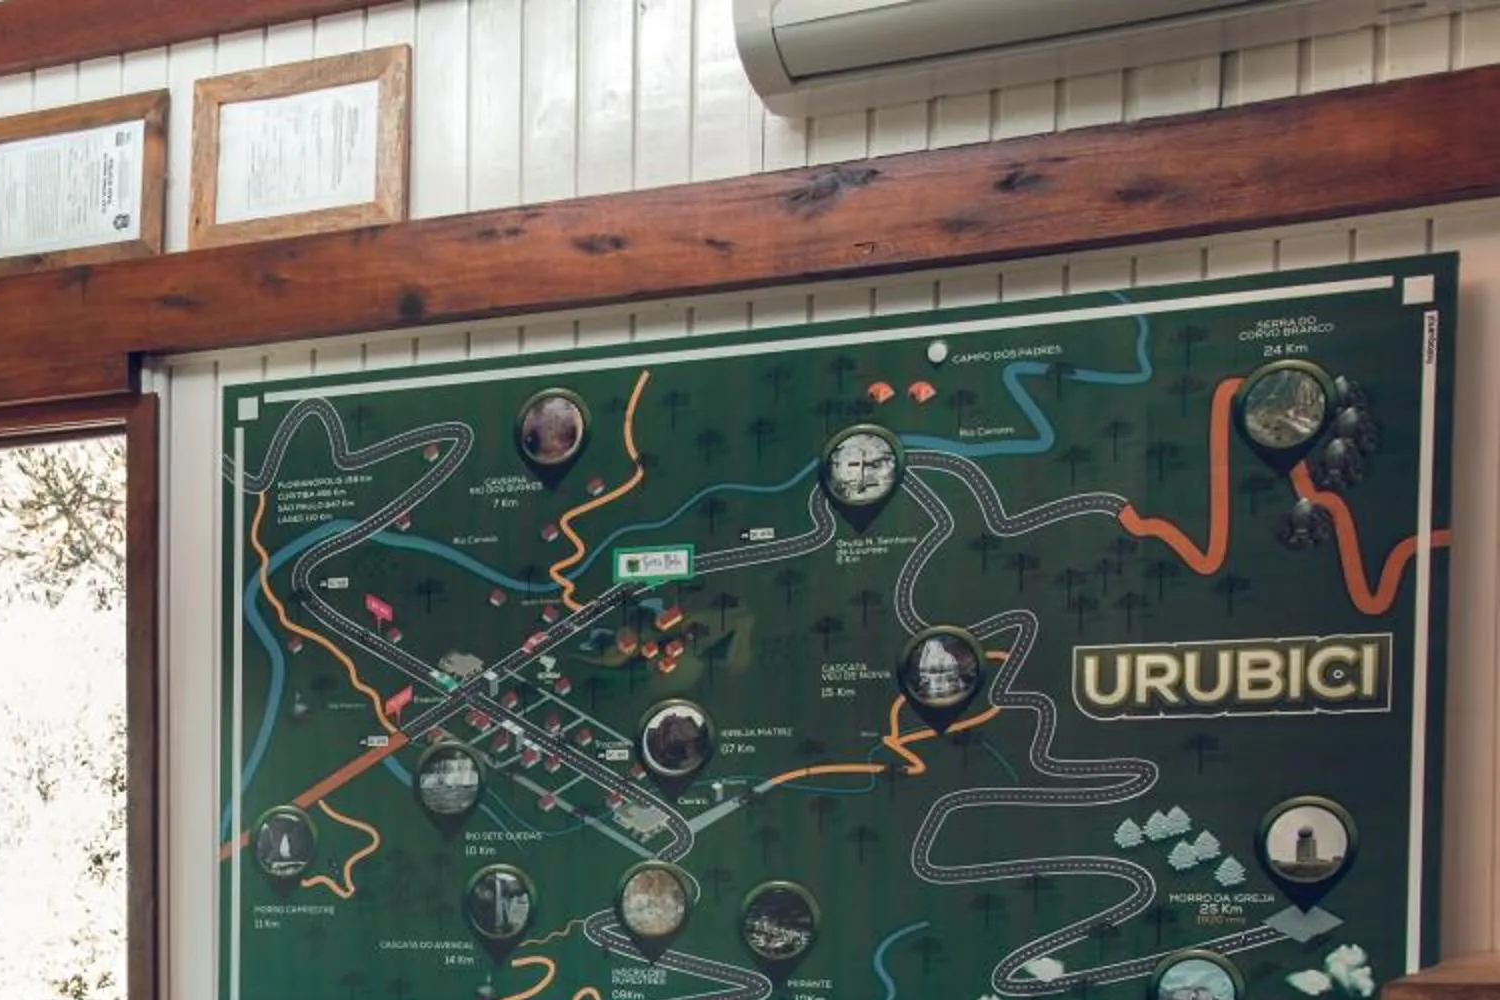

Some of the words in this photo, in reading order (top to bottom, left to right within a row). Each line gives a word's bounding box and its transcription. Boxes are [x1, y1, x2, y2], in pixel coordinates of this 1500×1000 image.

[1299, 315, 1317, 326] DO
[1238, 327, 1280, 342] CORVO
[1283, 322, 1335, 337] BRANCO
[951, 351, 992, 364] CAMPO
[993, 349, 1017, 360] DOS
[1018, 345, 1063, 357] PADRES
[1263, 345, 1282, 357] 24
[1285, 343, 1308, 354] Km
[492, 498, 500, 509] 7
[1083, 643, 1379, 706] URUBICI
[836, 687, 857, 697] Km
[737, 742, 757, 754] Km
[1169, 892, 1213, 904] MORRO
[1214, 892, 1231, 903] DA
[1199, 903, 1219, 916] 25
[1221, 903, 1243, 915] Km
[787, 979, 833, 989] MIRANTE
